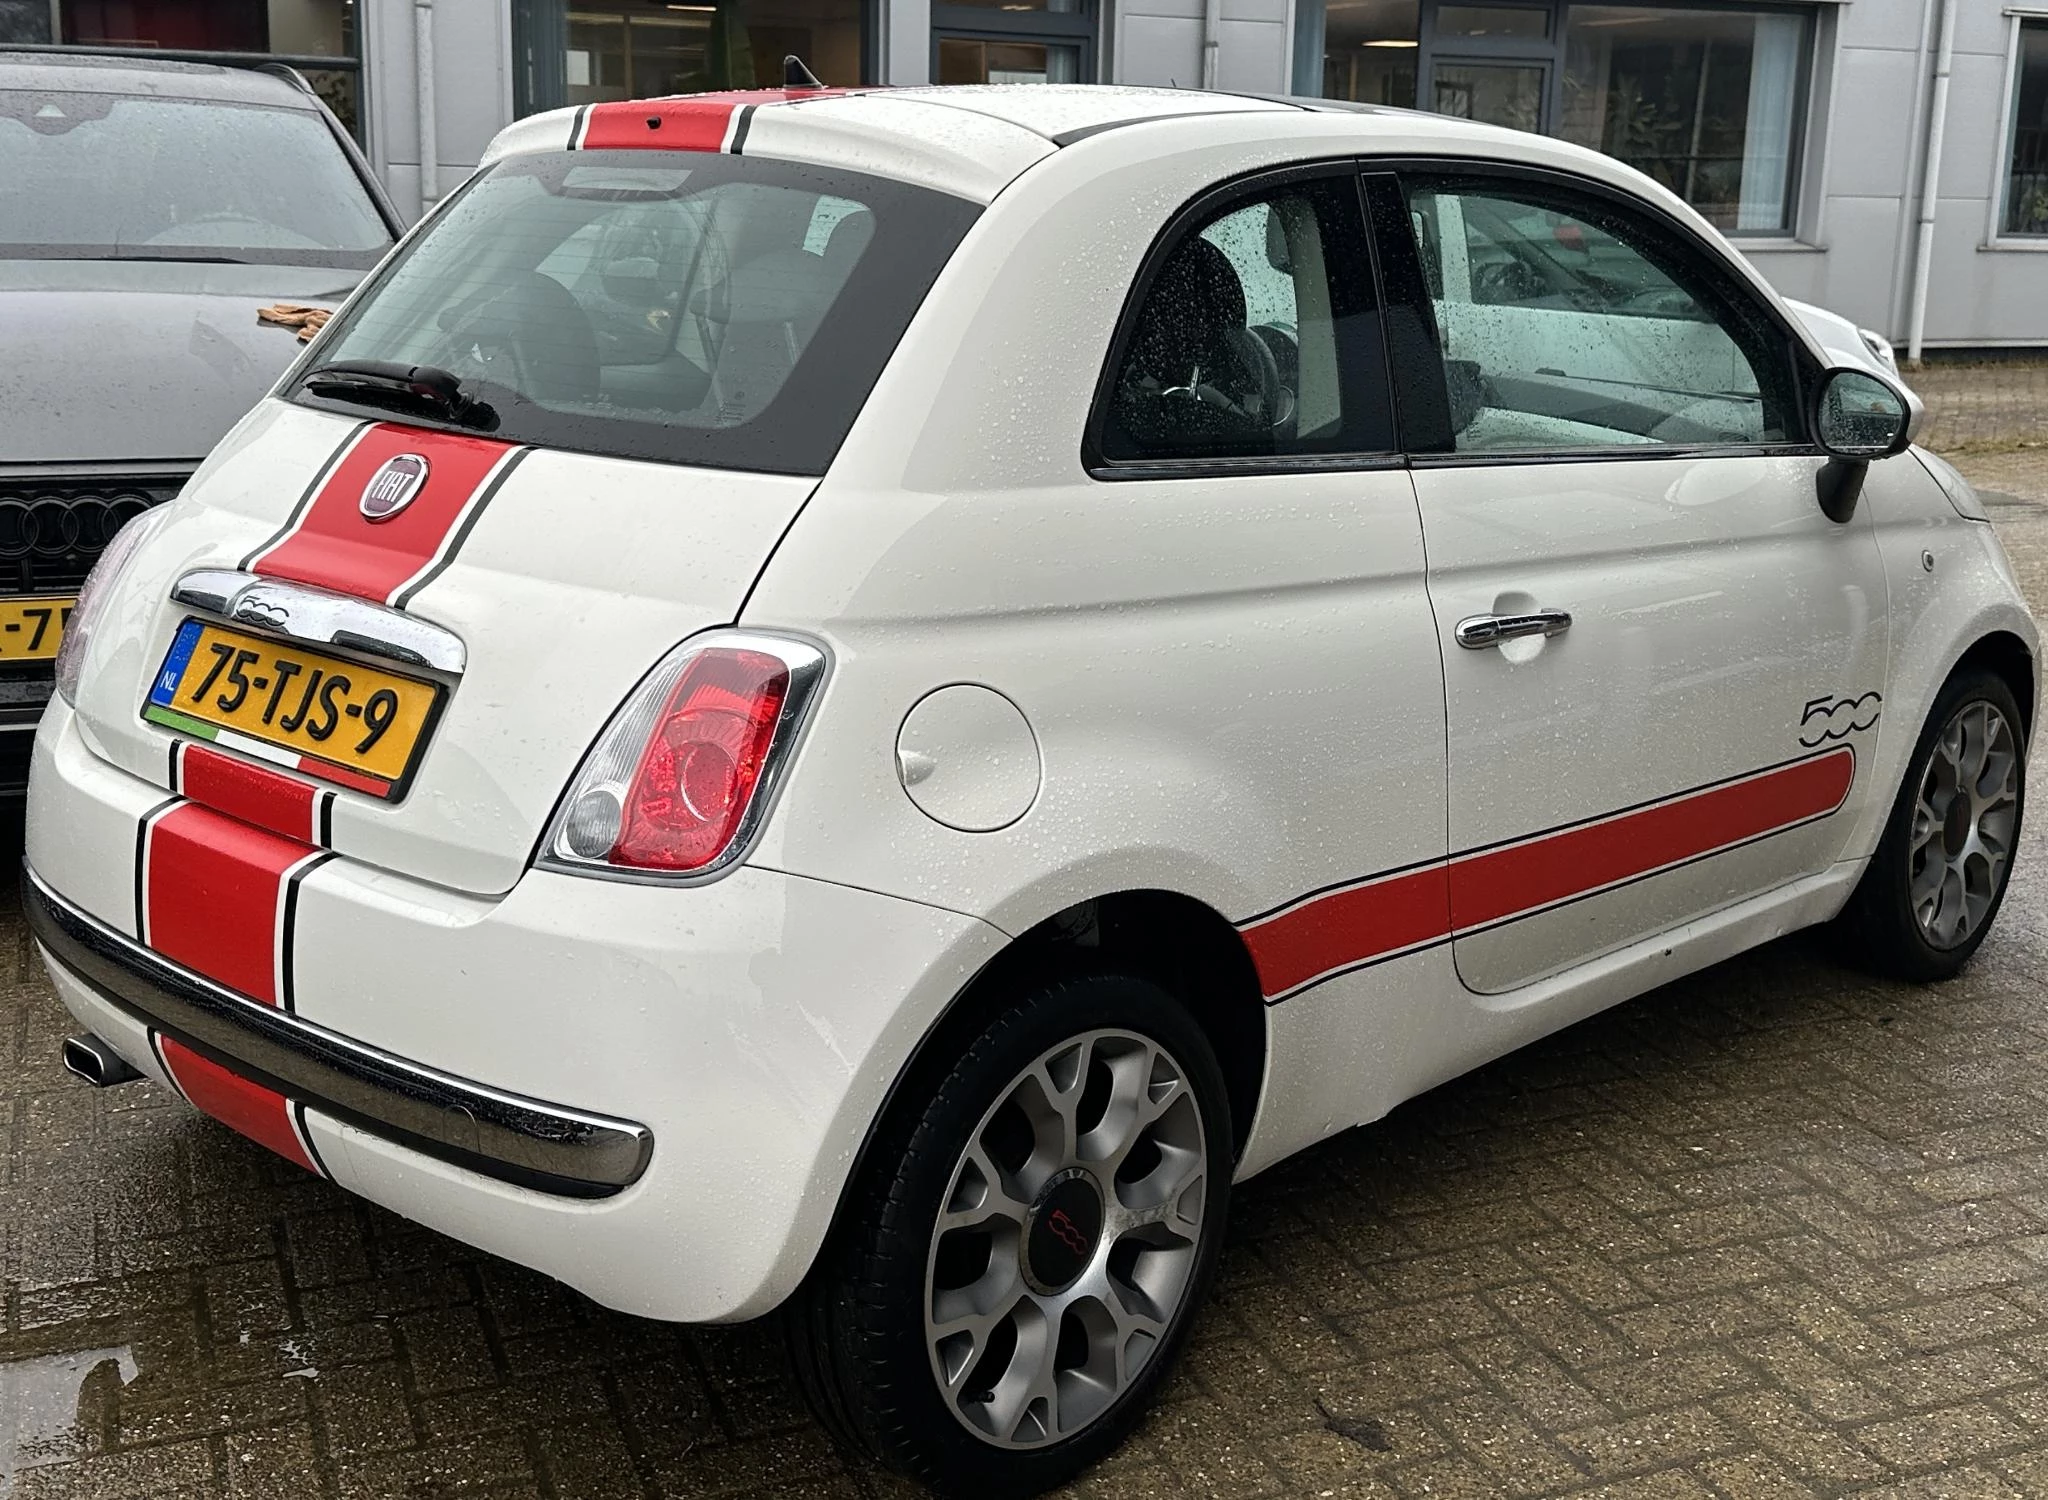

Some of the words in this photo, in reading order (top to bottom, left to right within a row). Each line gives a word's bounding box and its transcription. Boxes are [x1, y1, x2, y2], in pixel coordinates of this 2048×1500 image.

[371, 470, 415, 502] FIAT
[236, 595, 289, 627] 500
[160, 670, 177, 691] NL
[191, 642, 399, 755] 75-TJS-9
[1799, 691, 1882, 747] 500
